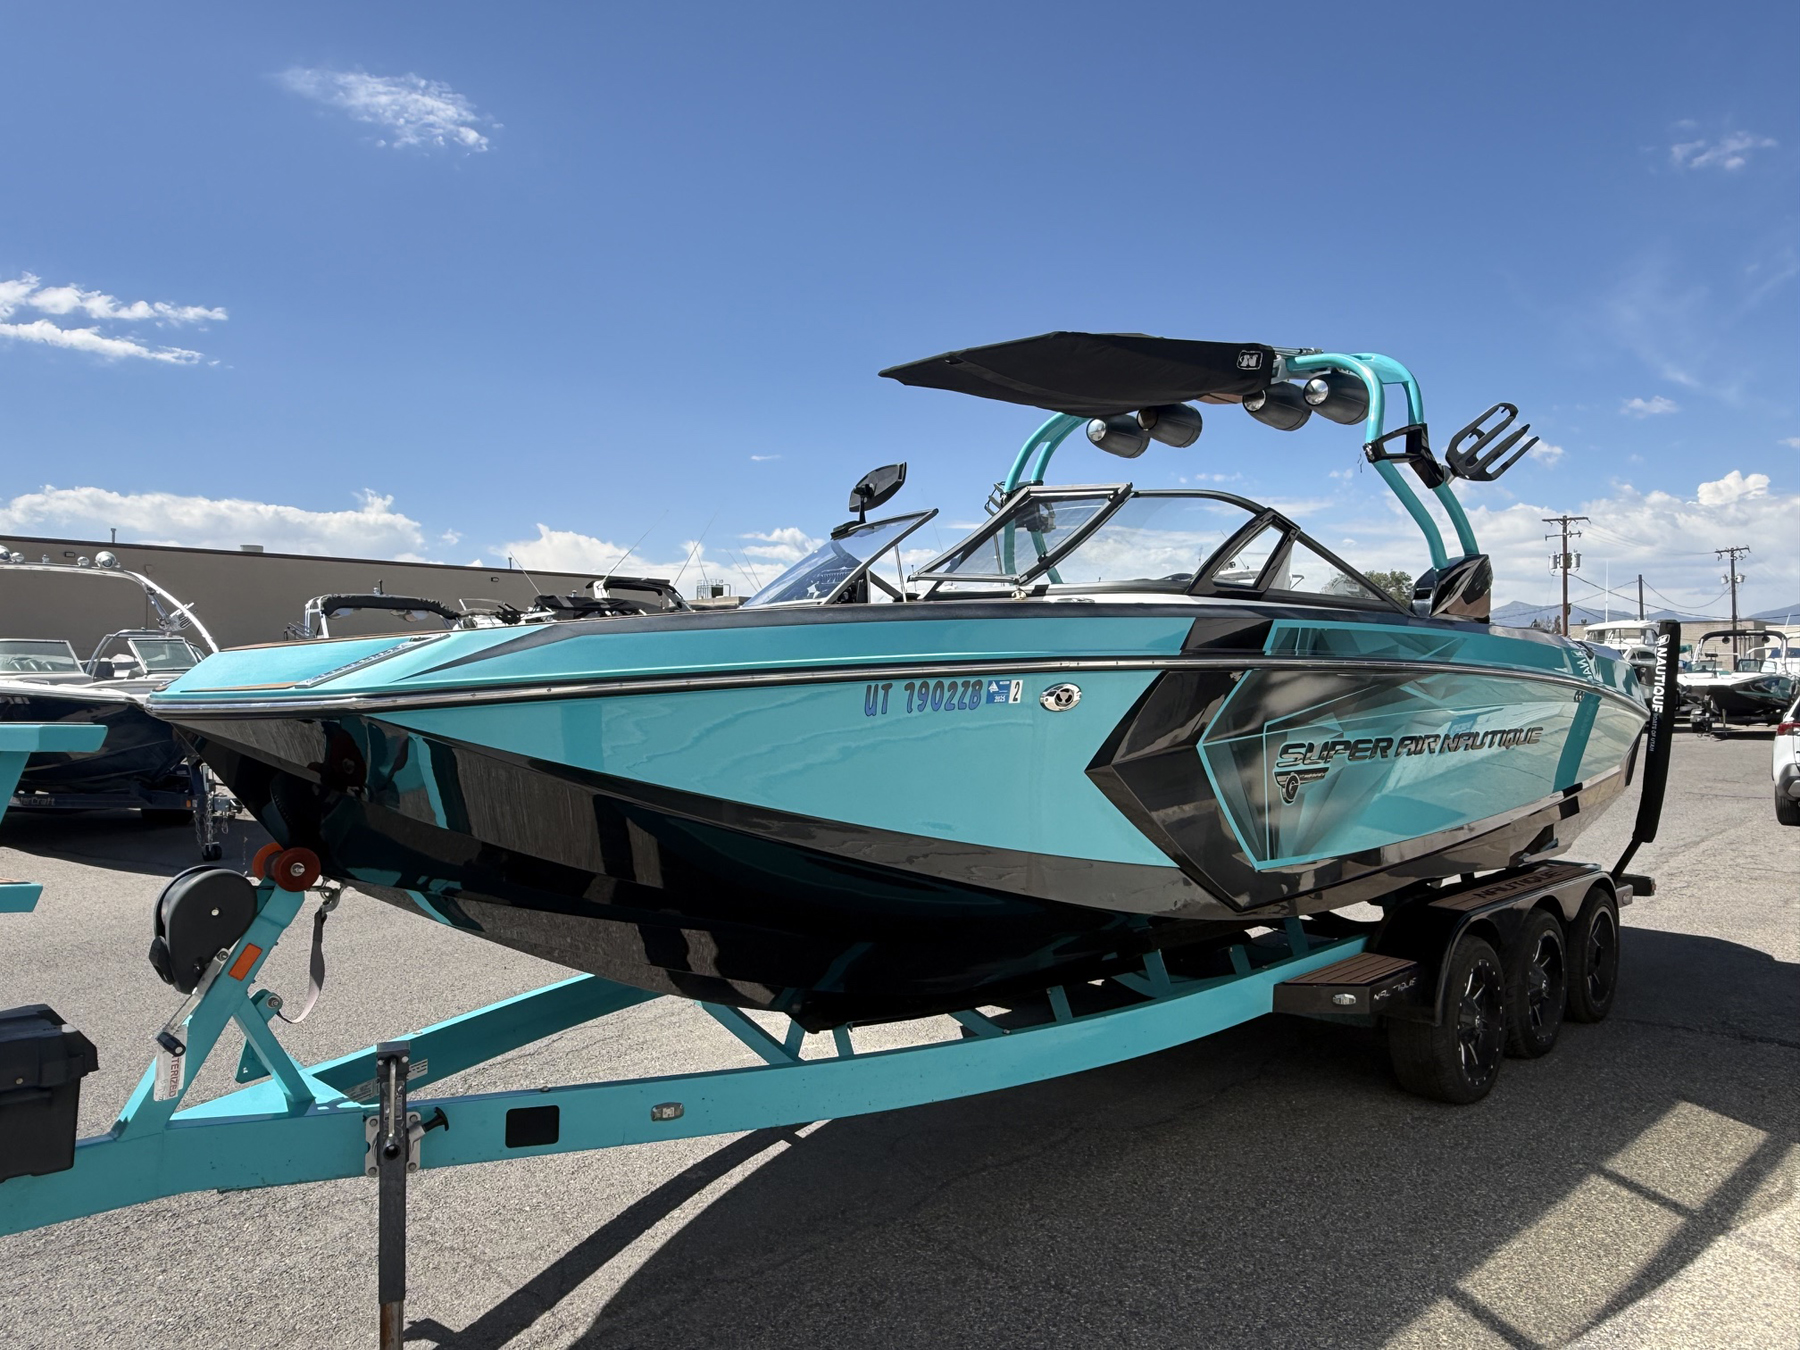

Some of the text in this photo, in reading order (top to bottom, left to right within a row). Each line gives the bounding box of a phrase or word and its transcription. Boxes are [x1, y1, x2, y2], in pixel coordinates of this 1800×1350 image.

[864, 683, 893, 716] UT
[1652, 647, 1668, 713] NAUTIQUE
[1278, 727, 1544, 767] SUPER AIR NAUTIQUE
[1473, 871, 1562, 898] NAUTIQUE
[169, 1055, 180, 1098] TERIZED
